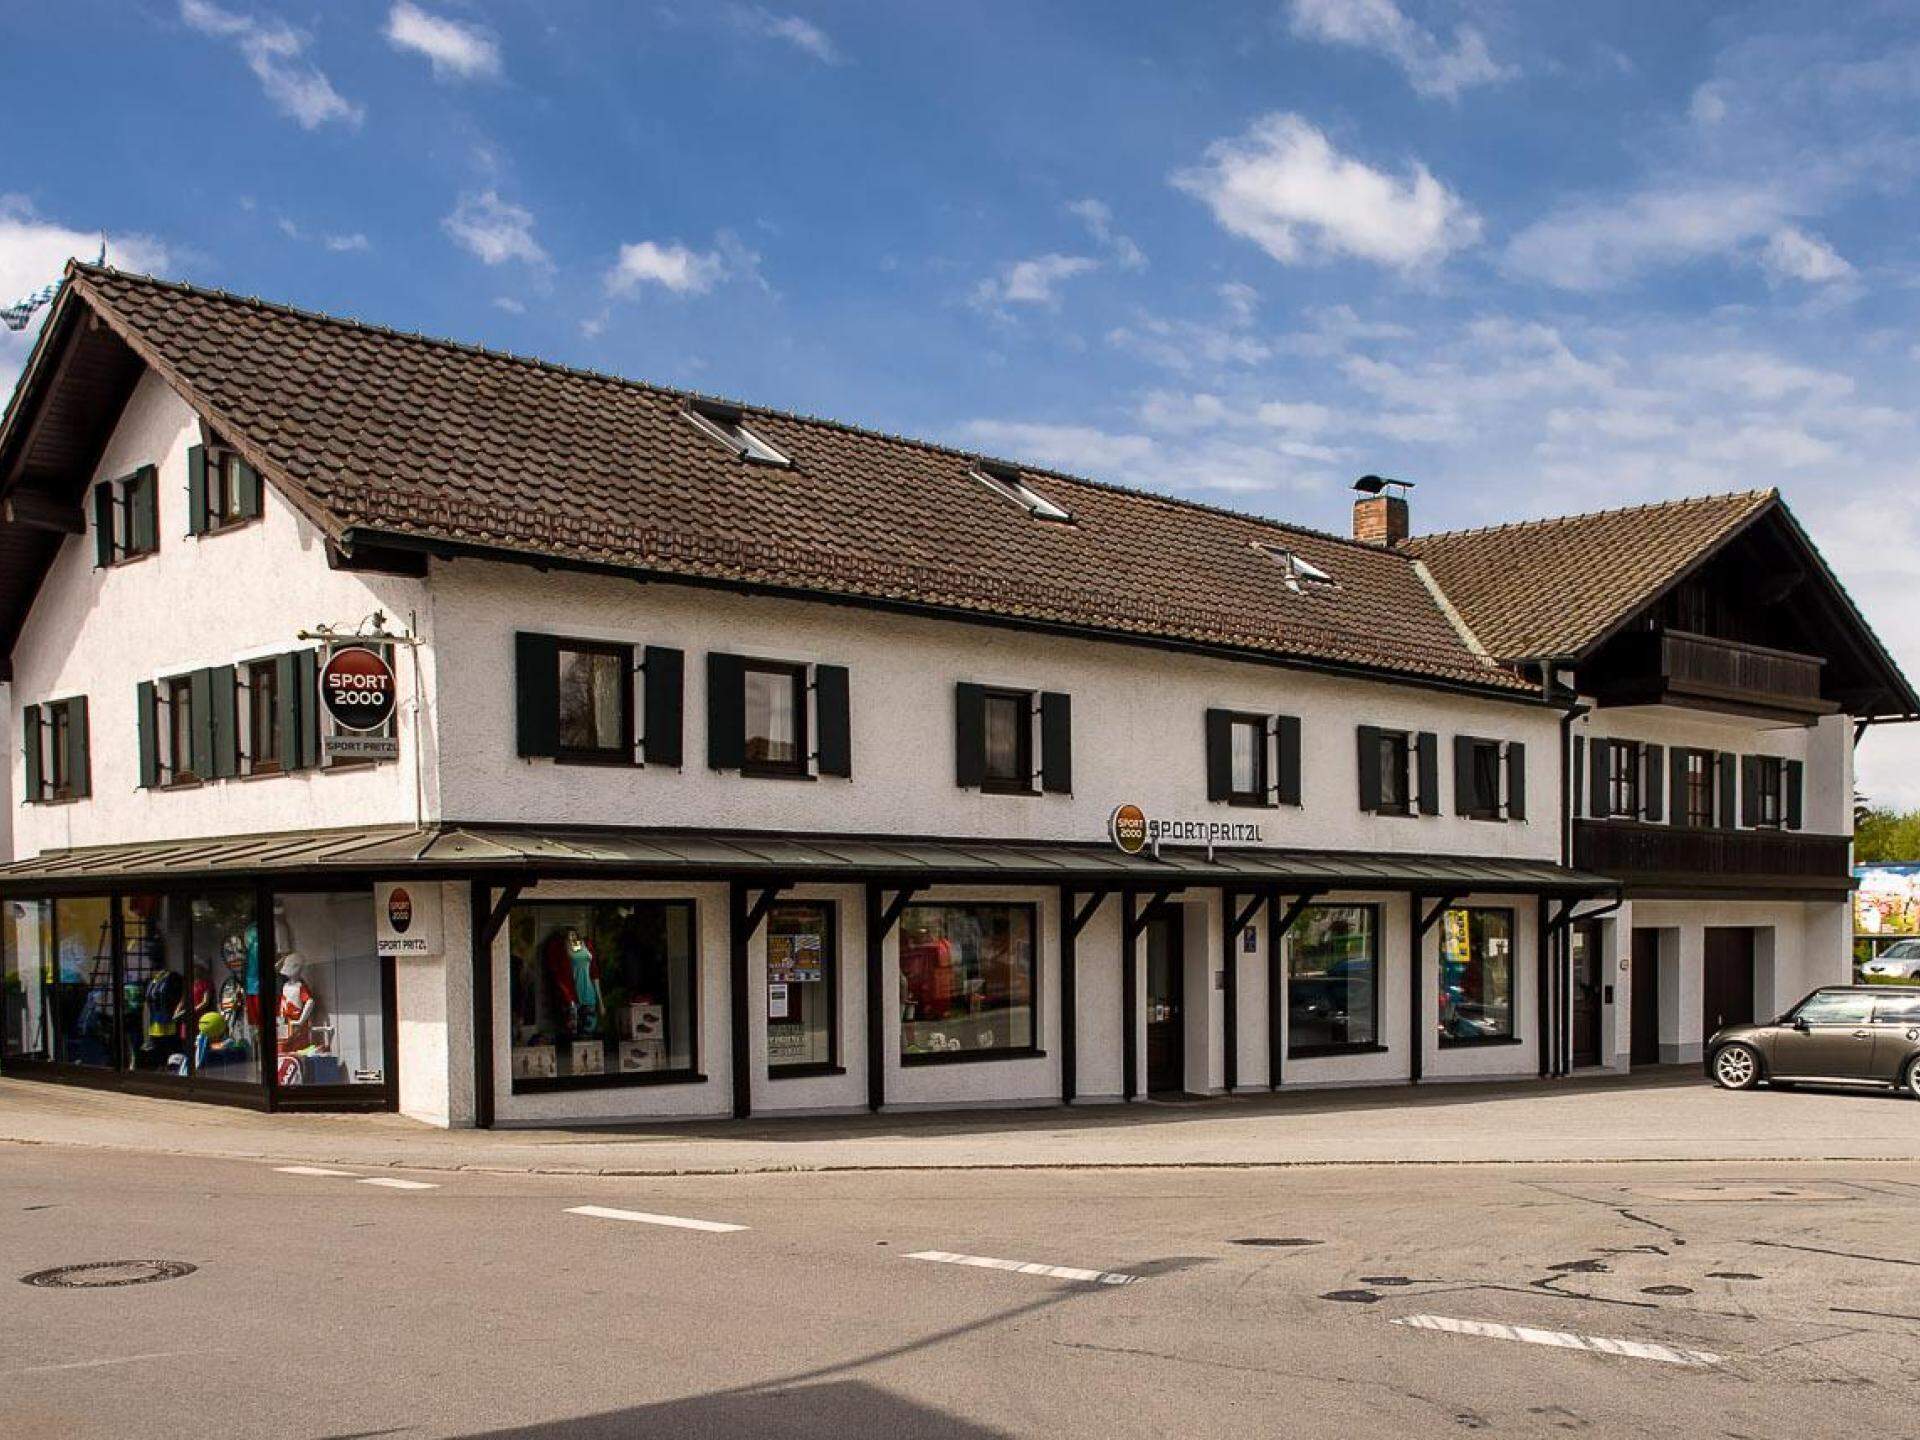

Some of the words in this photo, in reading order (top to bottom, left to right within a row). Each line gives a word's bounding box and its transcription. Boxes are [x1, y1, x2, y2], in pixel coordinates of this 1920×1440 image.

[329, 673, 388, 689] SPORT
[334, 690, 384, 705] 2000
[327, 741, 361, 752] SPORT
[1118, 818, 1143, 828] SPORT
[1120, 828, 1142, 838] 2000
[1149, 819, 1205, 840] SPORT
[1209, 822, 1263, 842] PRITZL
[378, 940, 401, 950] SPORT
